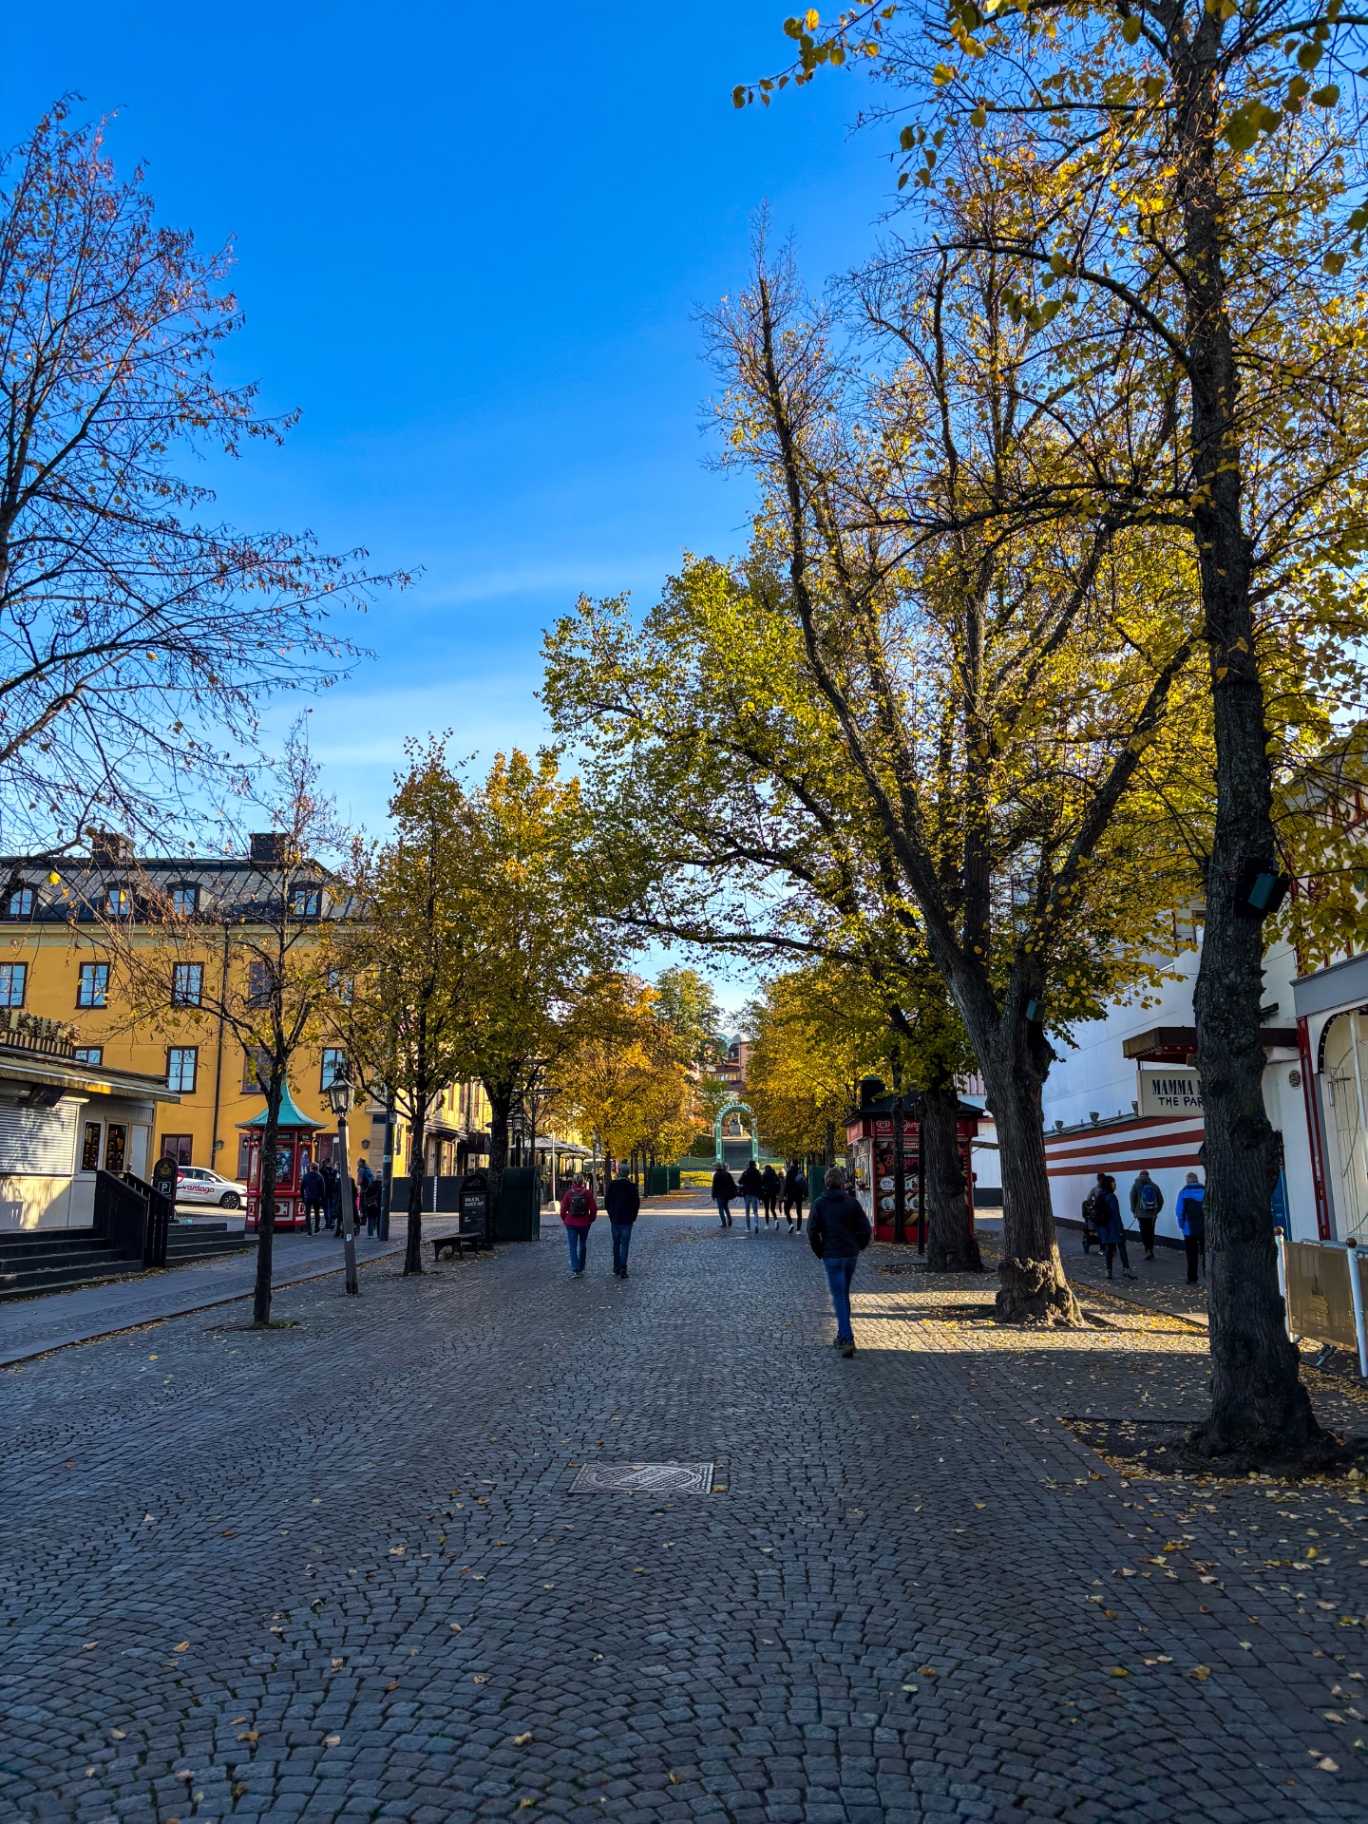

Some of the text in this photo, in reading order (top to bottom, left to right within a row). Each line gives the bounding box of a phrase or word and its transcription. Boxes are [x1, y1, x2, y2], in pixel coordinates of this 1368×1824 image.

[1152, 1079, 1194, 1095] MAMMA
[1158, 1096, 1204, 1108] THE PAR
[161, 1183, 168, 1191] P
[182, 1185, 215, 1194] vardaga
